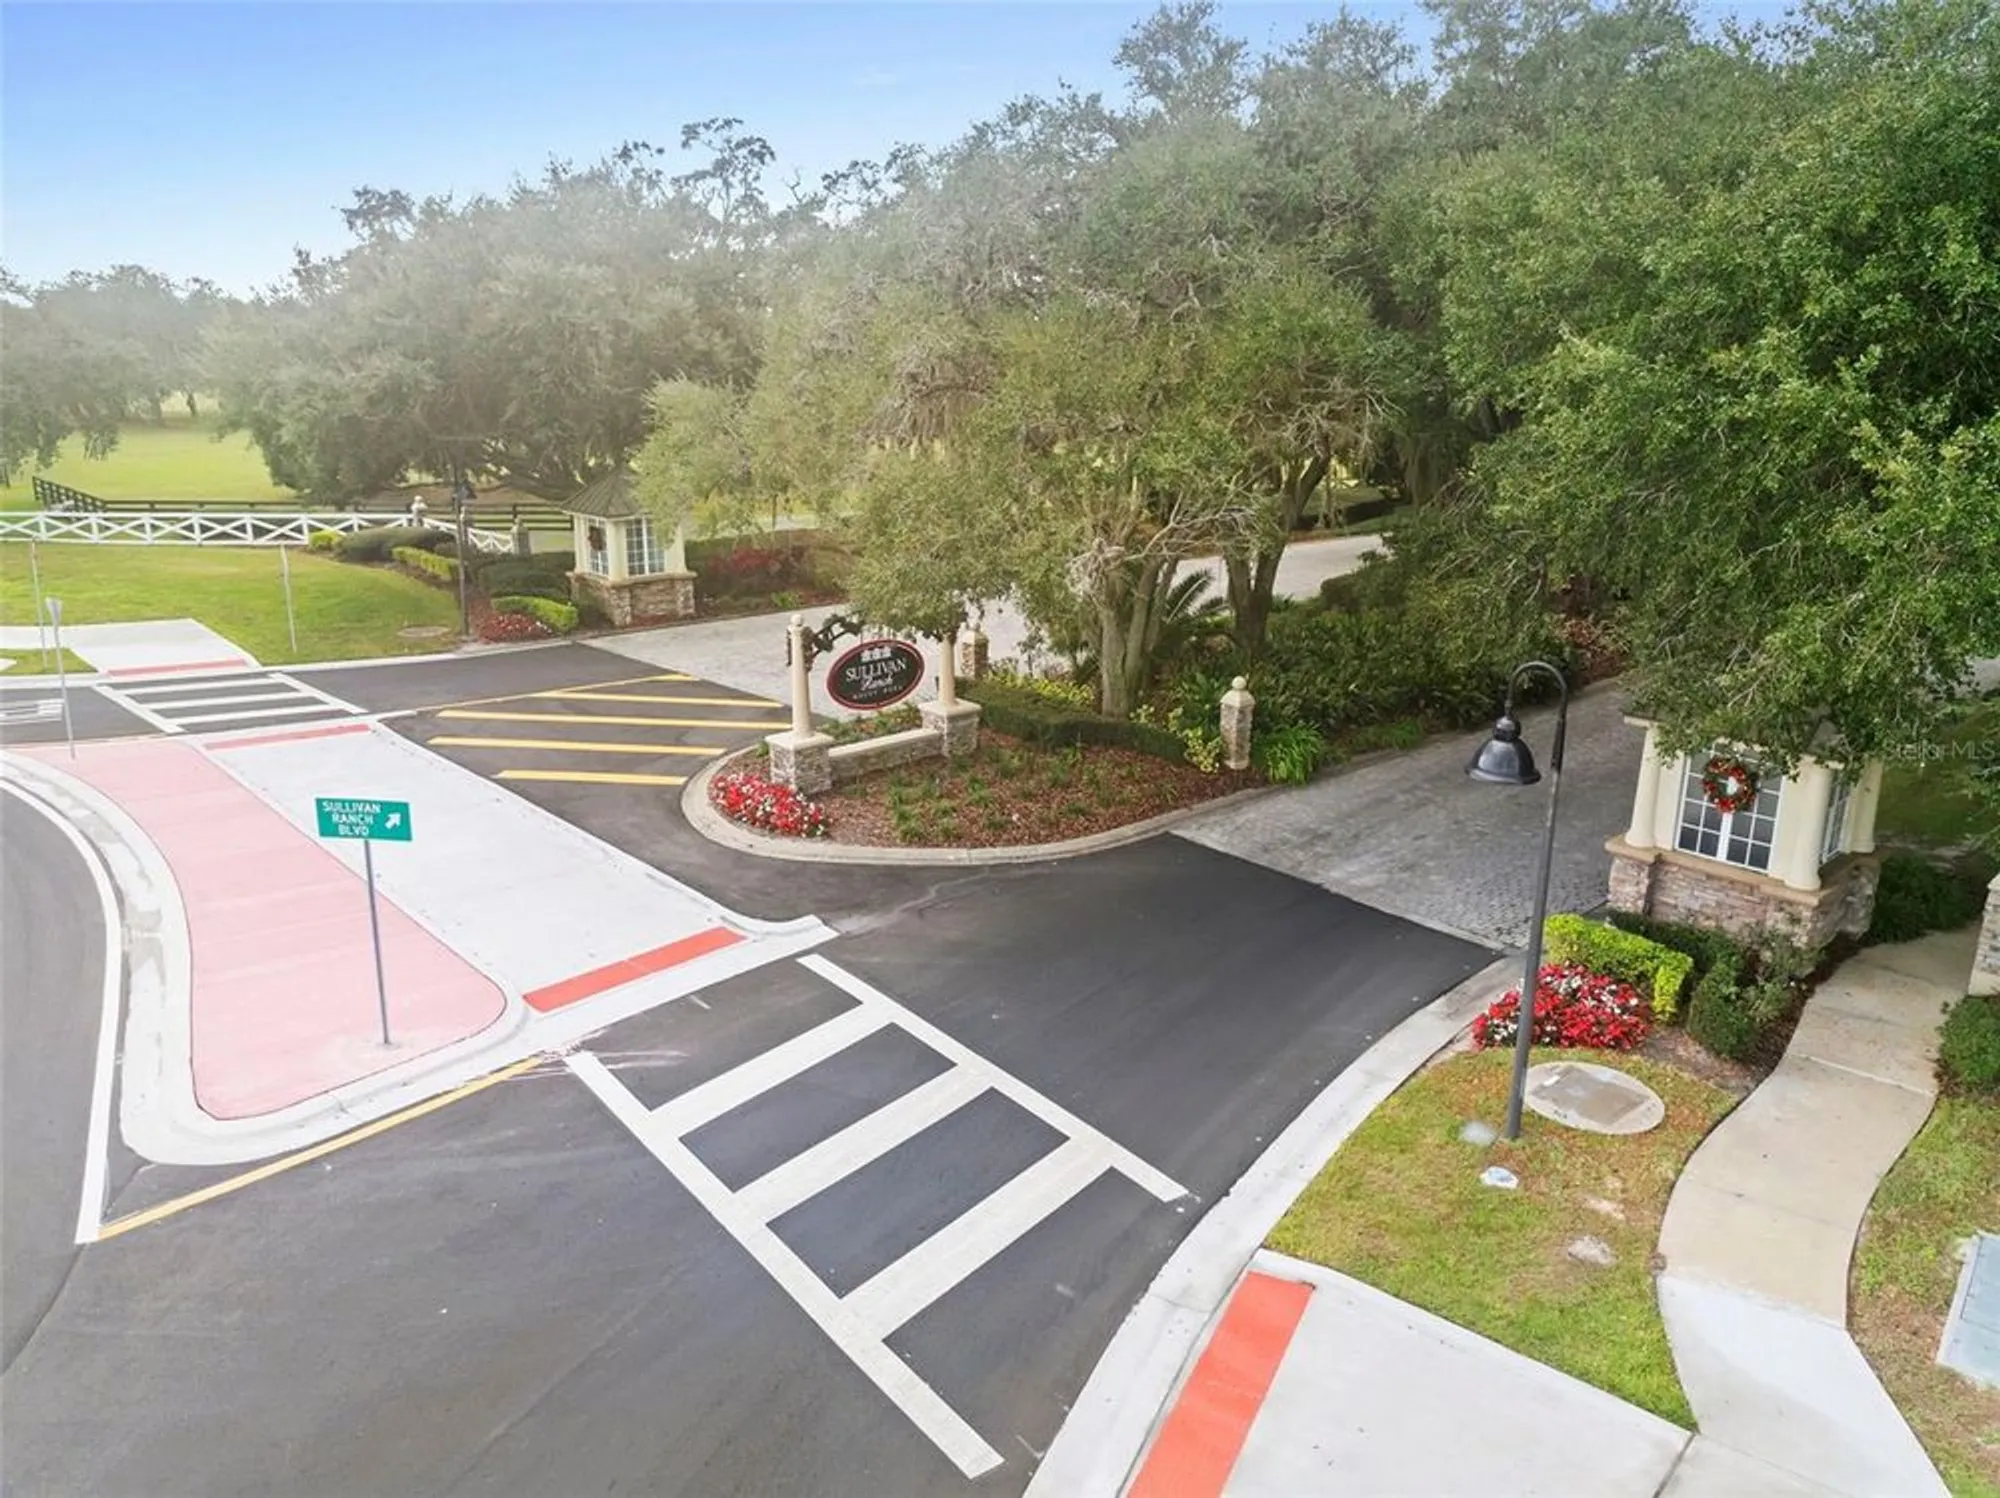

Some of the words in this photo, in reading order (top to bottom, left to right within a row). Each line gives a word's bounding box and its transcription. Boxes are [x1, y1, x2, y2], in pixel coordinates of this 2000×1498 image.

[845, 658, 907, 682] SULLIVAN
[322, 801, 381, 814] SULLIVAN
[331, 813, 374, 825] RANCH
[338, 824, 370, 836] BLVD
